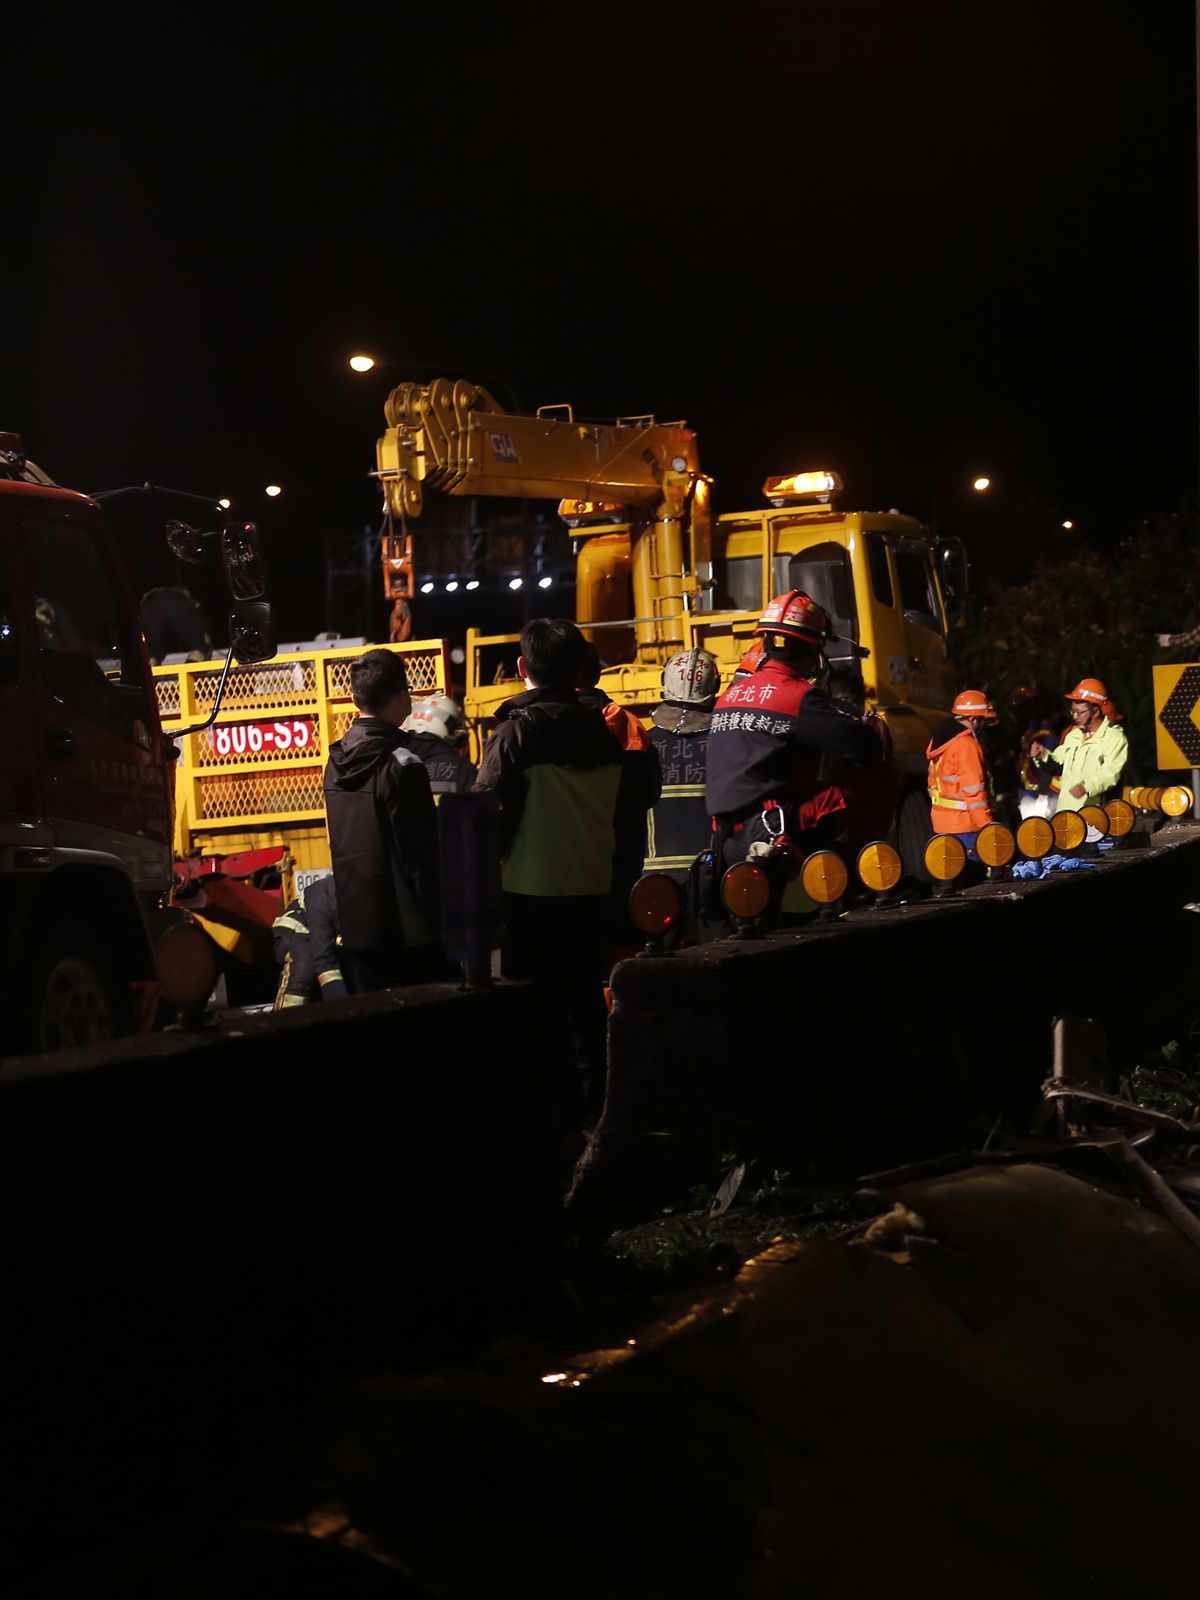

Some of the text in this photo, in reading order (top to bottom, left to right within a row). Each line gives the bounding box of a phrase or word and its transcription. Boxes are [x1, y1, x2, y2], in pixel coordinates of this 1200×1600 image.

[725, 684, 777, 704] 新北市
[215, 721, 309, 755] 806-S5
